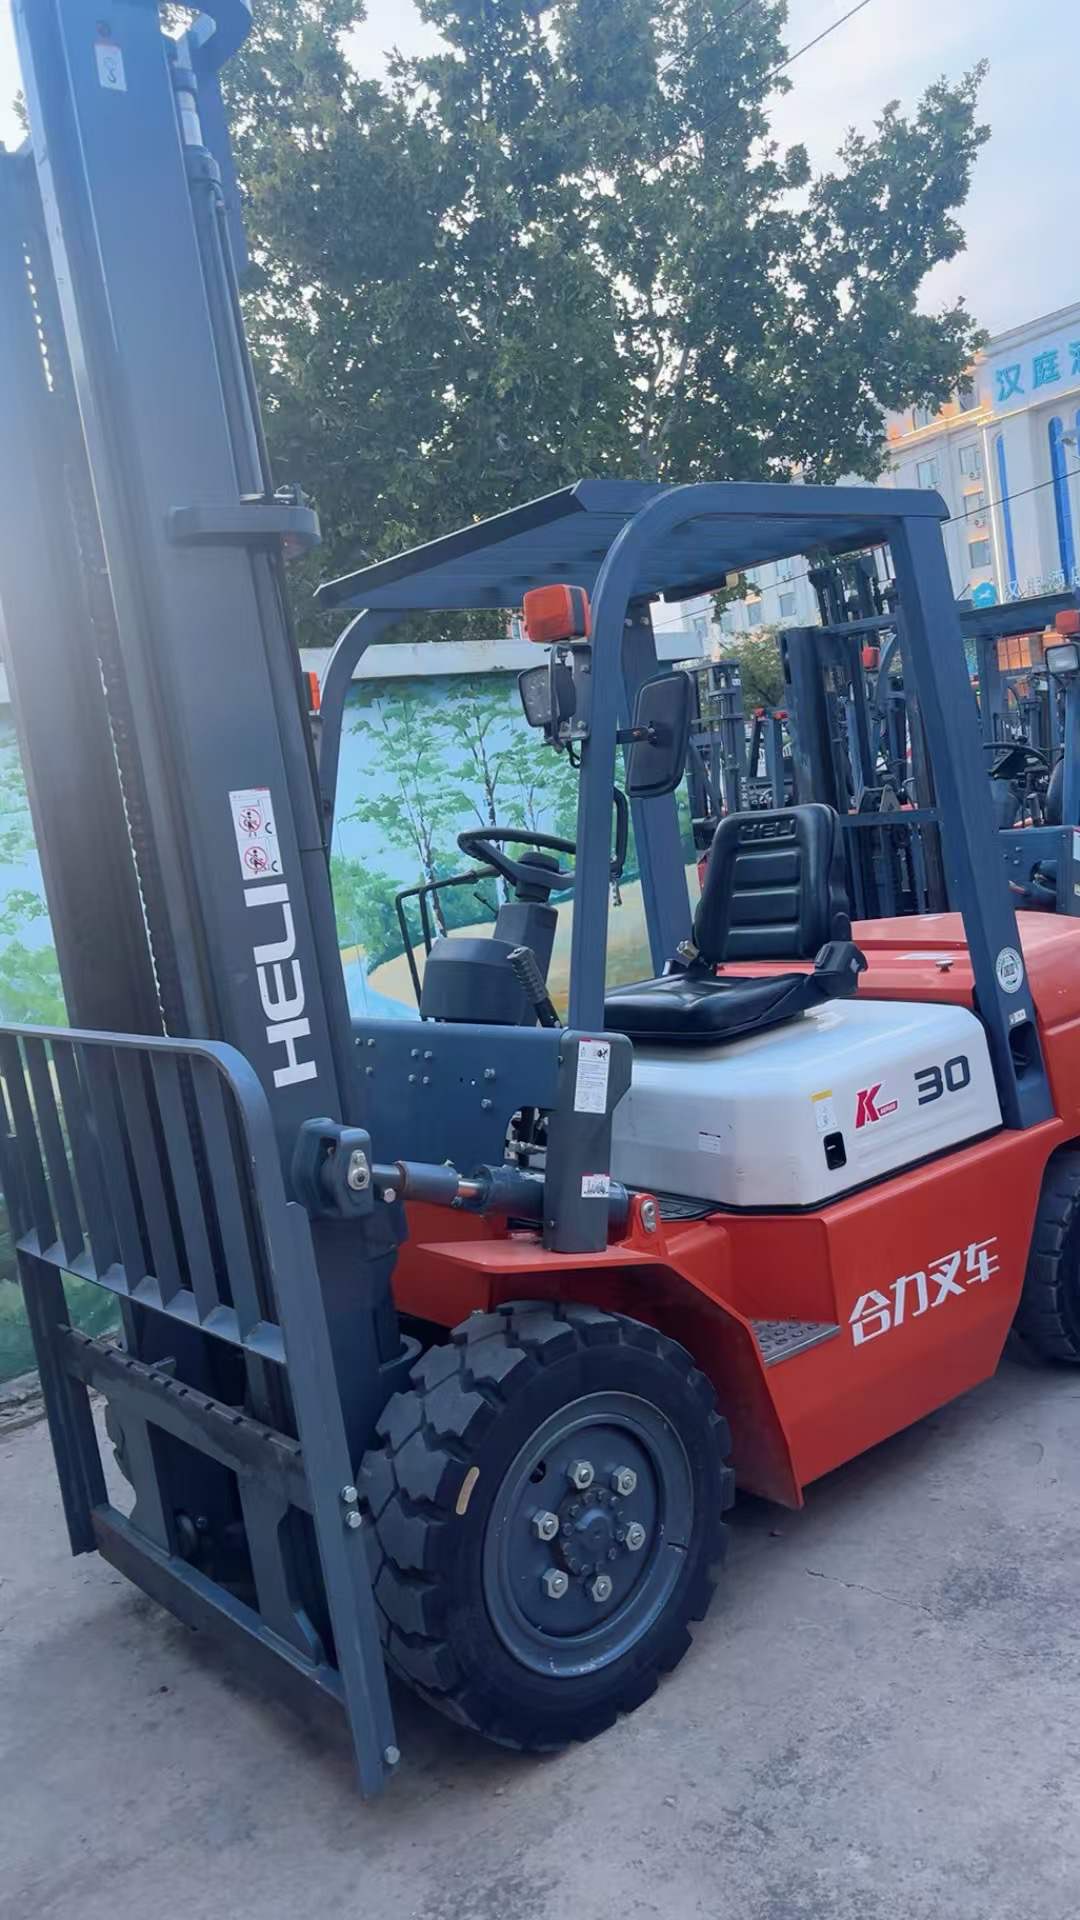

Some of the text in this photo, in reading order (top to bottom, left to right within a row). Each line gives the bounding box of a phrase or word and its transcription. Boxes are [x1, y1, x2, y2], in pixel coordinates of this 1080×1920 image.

[243, 883, 318, 1088] HELI
[855, 1083, 881, 1129] K
[914, 1055, 970, 1106] 30
[848, 1236, 1000, 1346] 合力叉车
